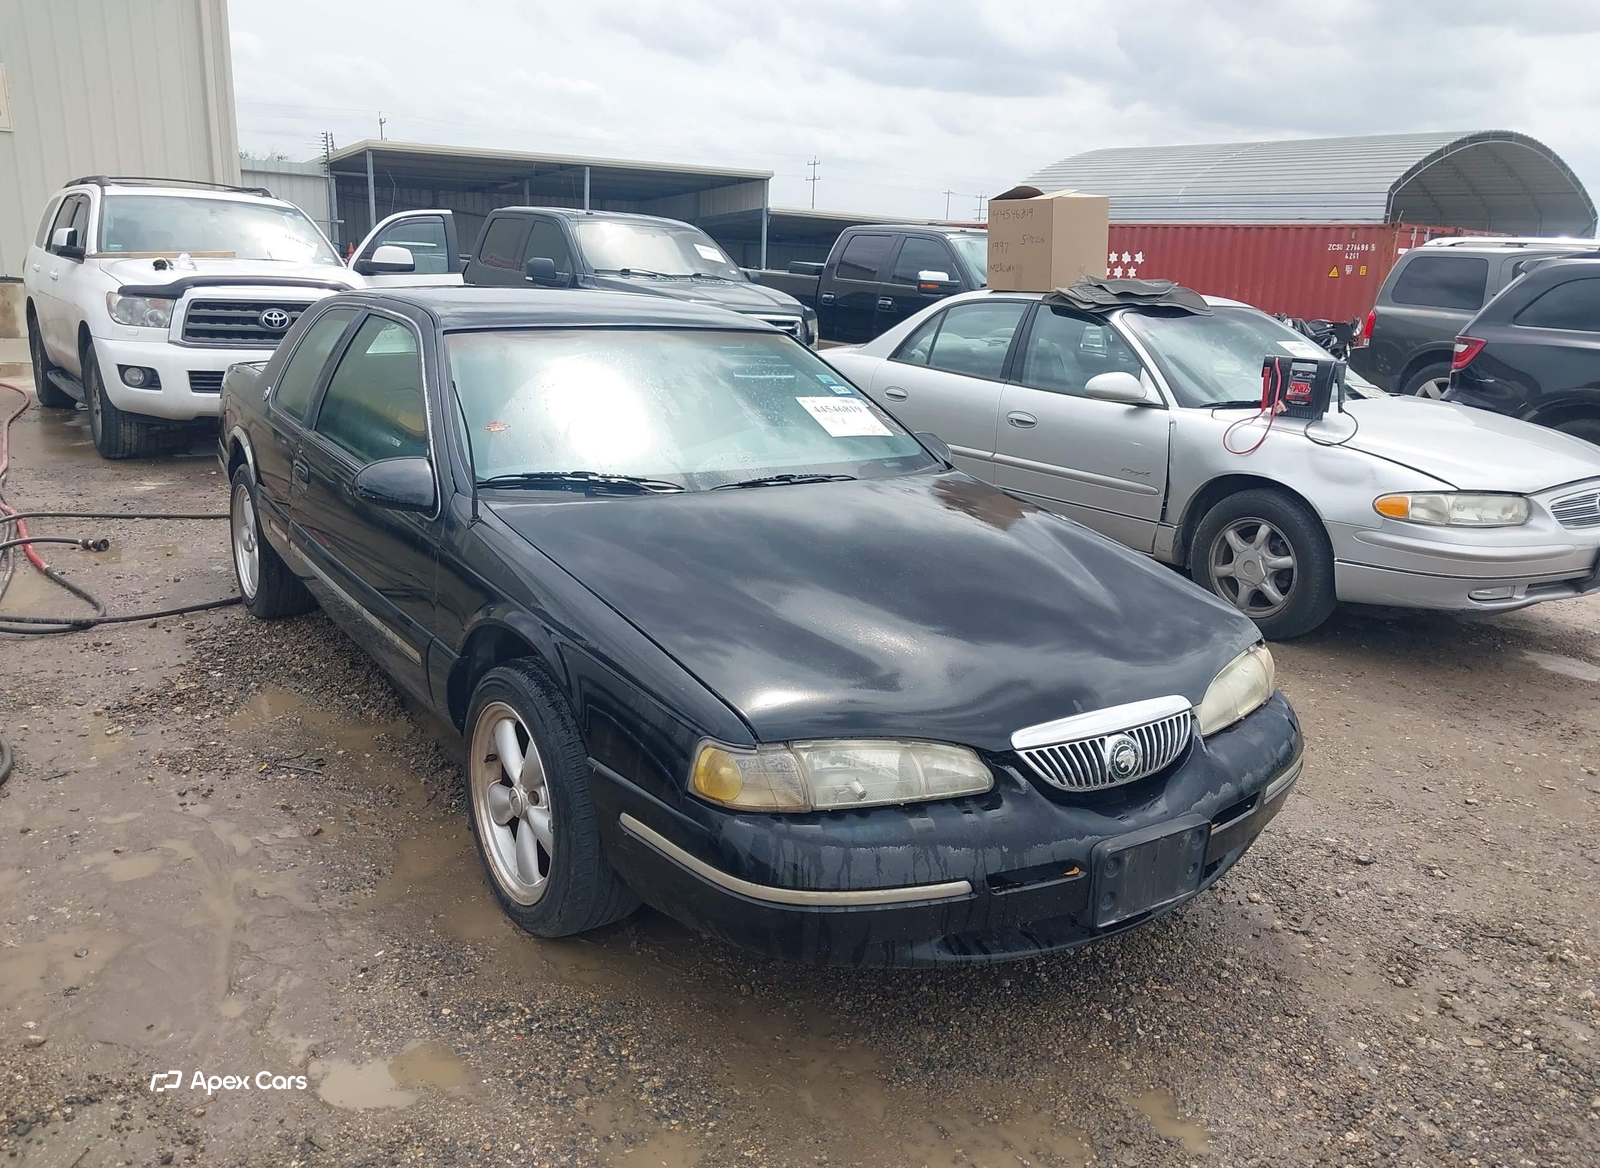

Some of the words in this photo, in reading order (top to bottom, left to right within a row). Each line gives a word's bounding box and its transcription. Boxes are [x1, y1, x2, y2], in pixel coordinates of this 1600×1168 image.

[991, 241, 1009, 255] 1997
[1328, 243, 1343, 251] ZCSU
[813, 405, 863, 414] 44546819
